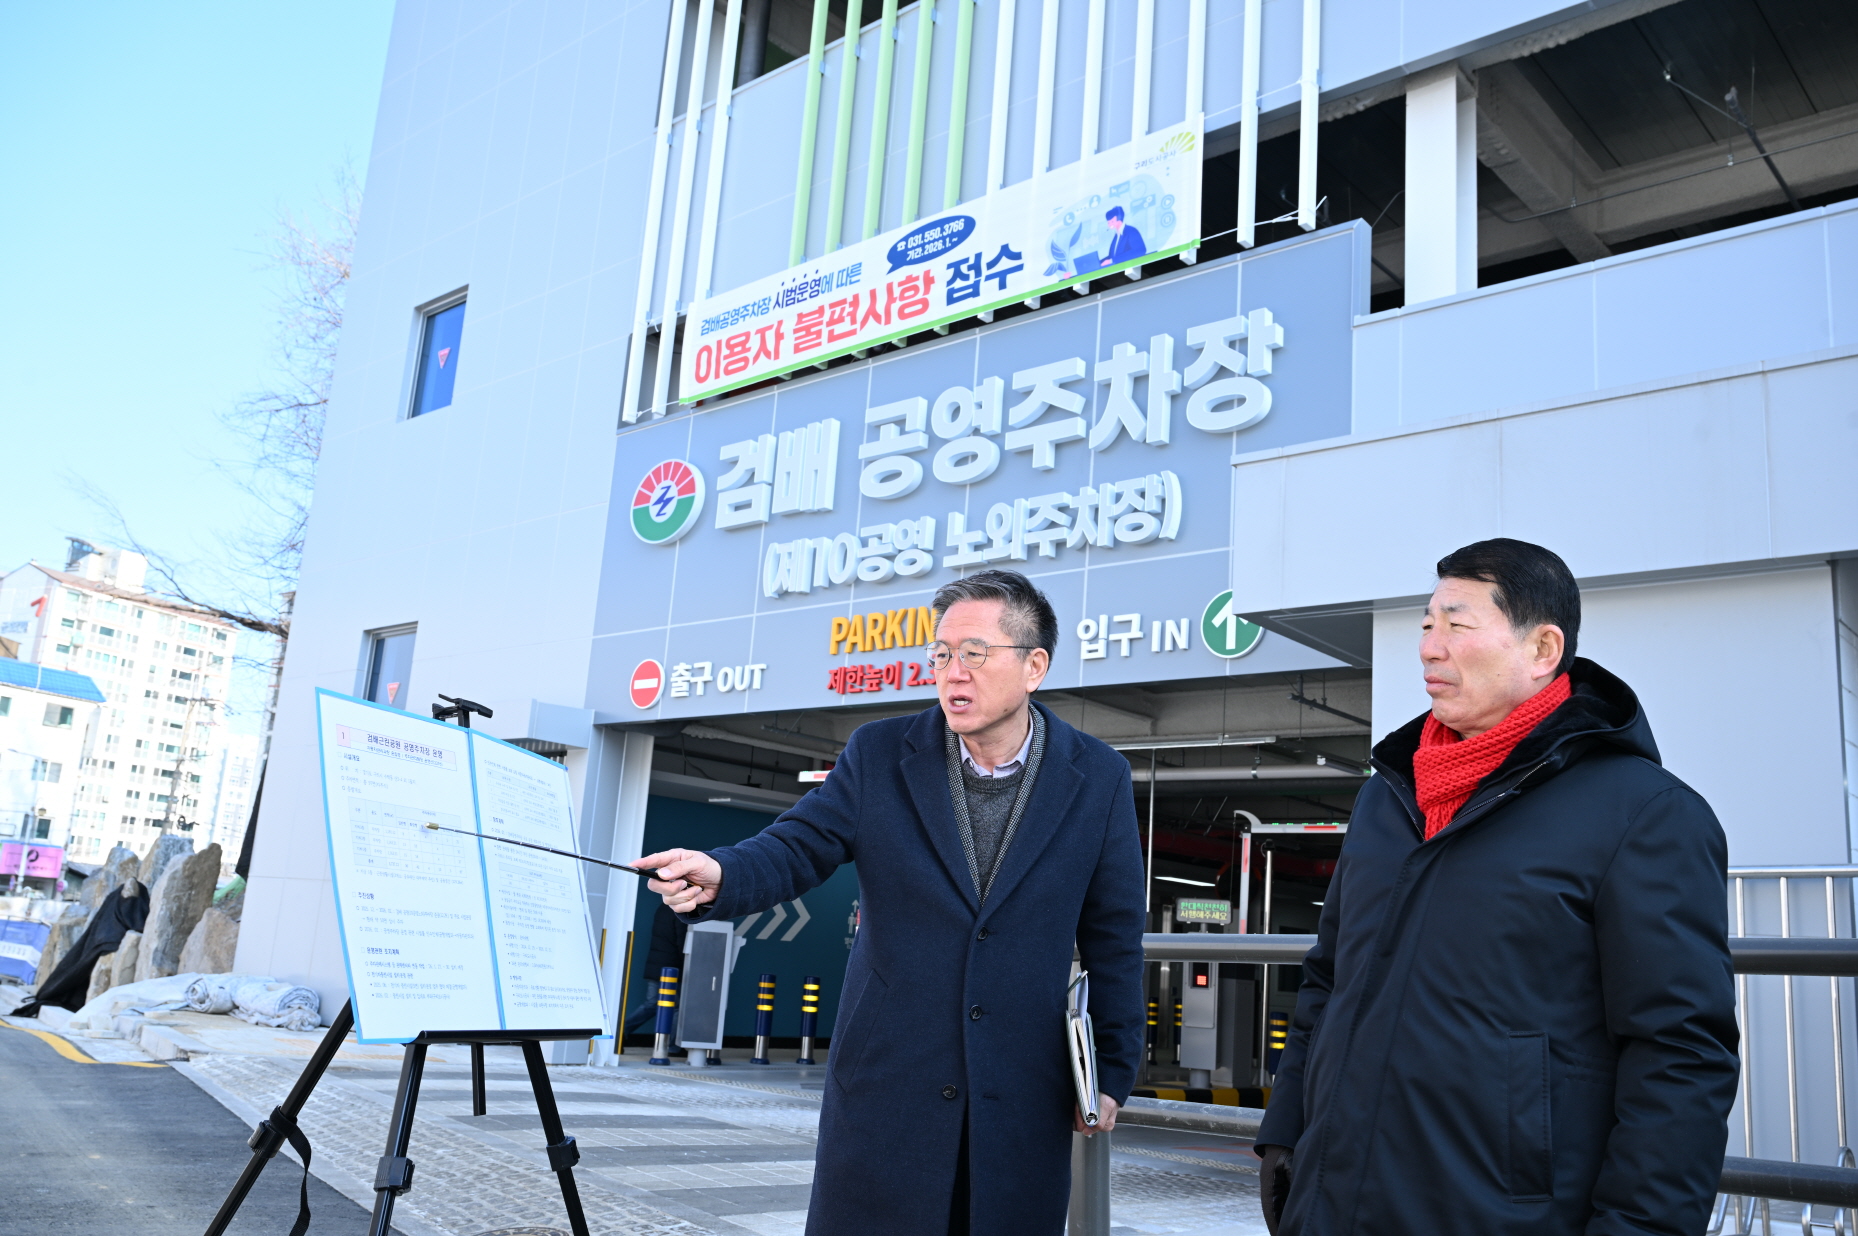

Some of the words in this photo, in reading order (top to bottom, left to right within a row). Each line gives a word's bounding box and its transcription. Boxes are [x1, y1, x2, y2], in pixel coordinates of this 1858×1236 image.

[908, 219, 964, 248] 031.550.3766
[694, 318, 785, 384] 이용자
[793, 269, 936, 355] 불편사항
[945, 243, 1025, 306] 접수
[700, 296, 772, 336] 검배공영주차장
[772, 272, 834, 311] 시범운영에
[835, 262, 863, 288] 따른
[714, 417, 841, 530] 검배
[857, 309, 1284, 500] 공영주차장
[762, 514, 937, 599] (제10공영
[942, 469, 1183, 569] 노외주차장)
[829, 606, 938, 655] PARKIN
[1076, 613, 1144, 660] 입구
[1150, 617, 1190, 653] IN
[670, 660, 714, 698] 출구
[716, 663, 767, 692] OUT
[826, 660, 903, 695] 제한높이
[403, 742, 430, 756] 공영주차장
[432, 748, 444, 759] 운영
